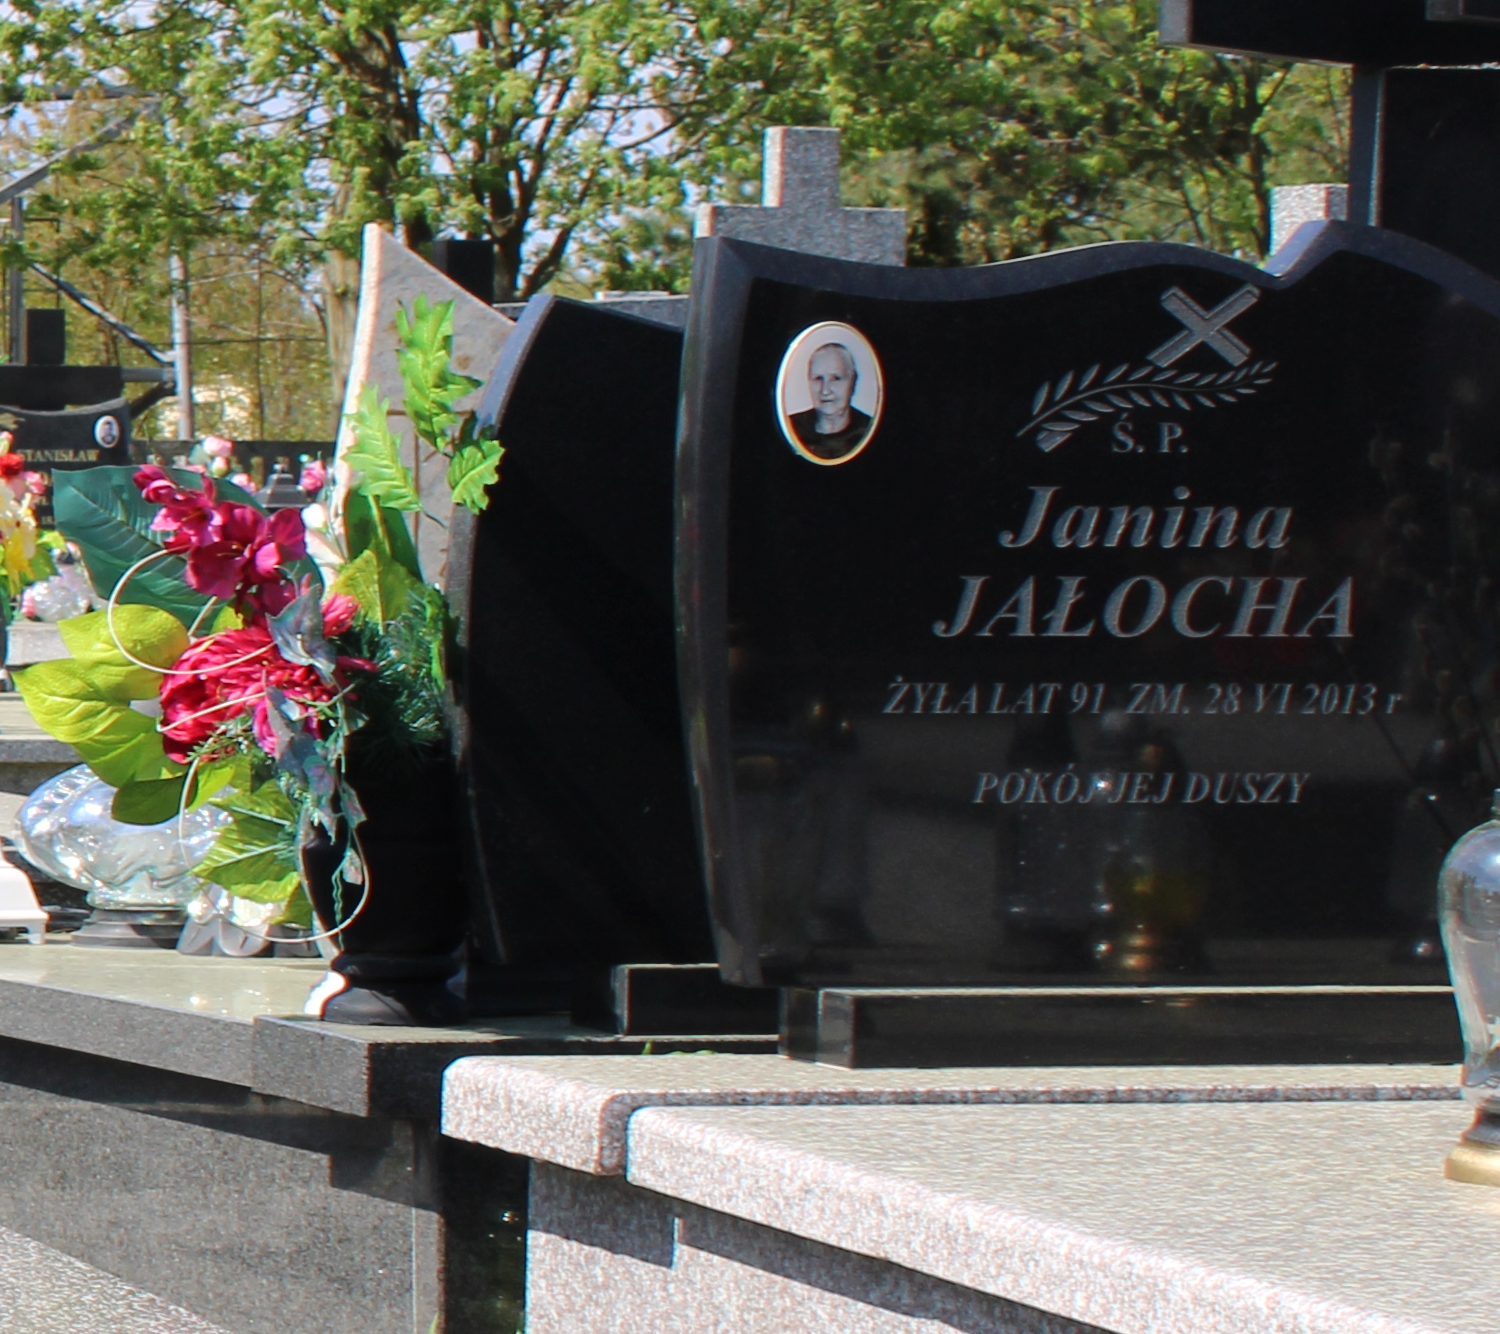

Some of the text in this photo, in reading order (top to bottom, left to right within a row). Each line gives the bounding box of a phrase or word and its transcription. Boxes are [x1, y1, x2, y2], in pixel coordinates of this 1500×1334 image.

[998, 485, 1295, 549] Janina
[931, 574, 1355, 639] JAŁOCHA
[882, 675, 980, 715] ŻYŁA
[987, 682, 1062, 715] LAT
[1125, 682, 1191, 715] ZM.
[1203, 682, 1243, 715] 28
[1253, 682, 1295, 715] VI
[1300, 682, 1380, 715] 2013
[1384, 692, 1404, 715] r
[971, 763, 1311, 804] POKÓJ JEJ DUSZY
